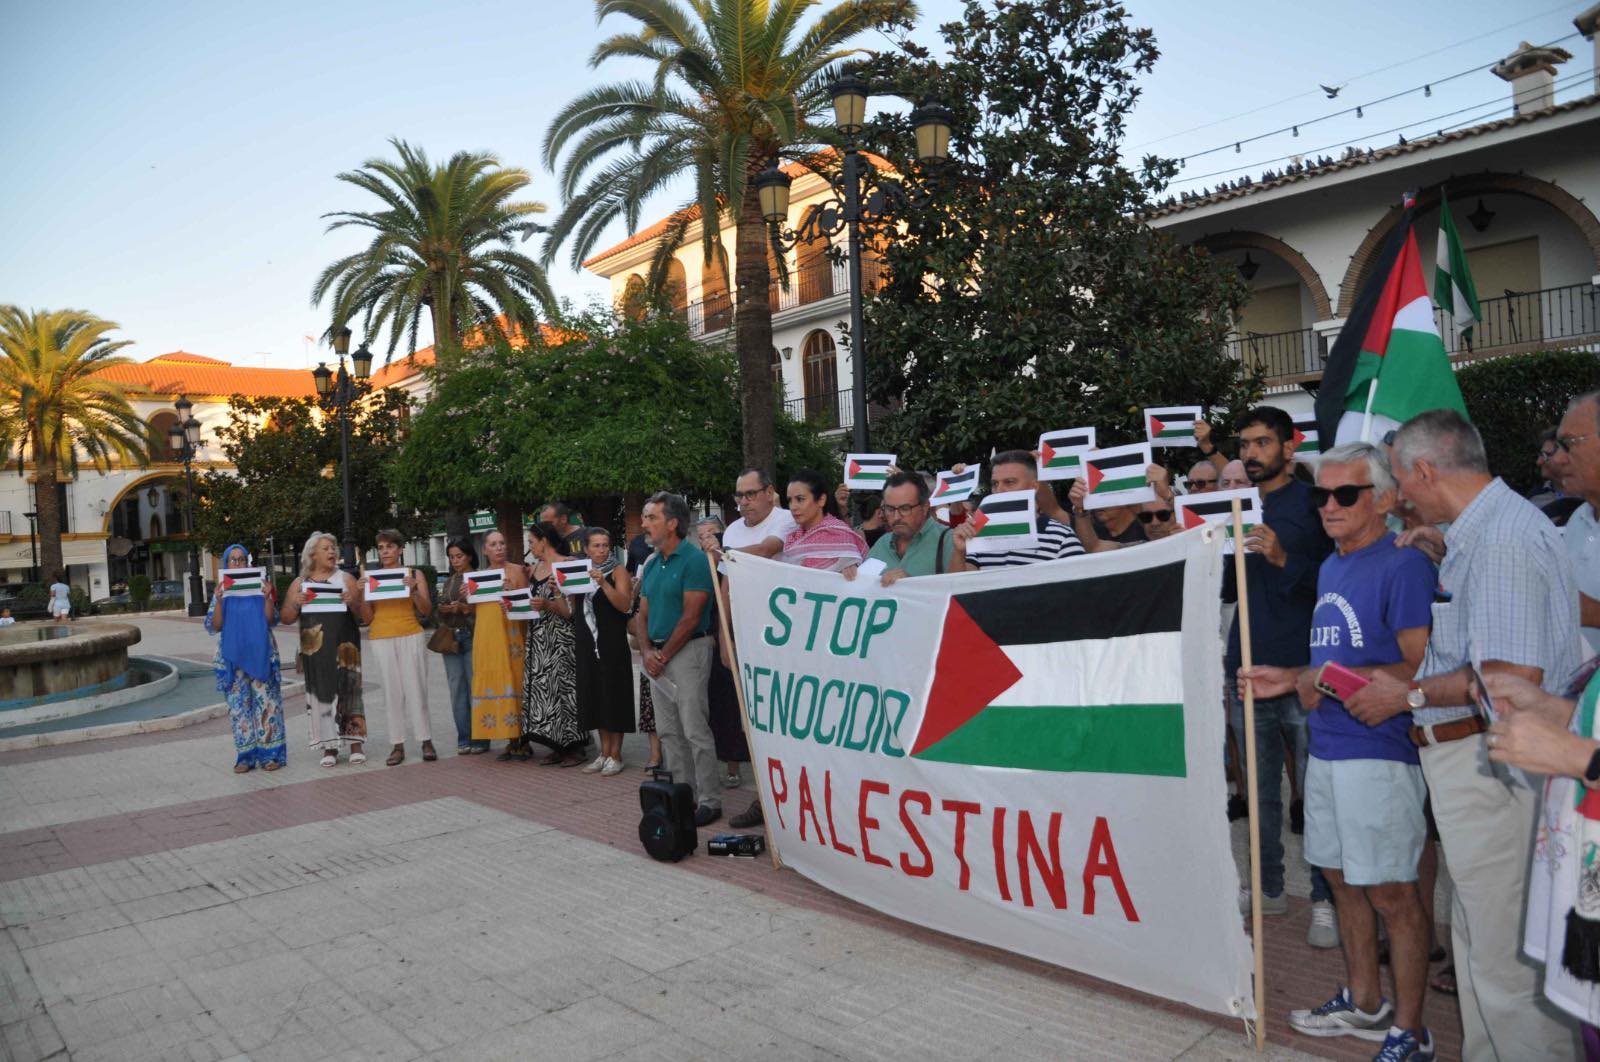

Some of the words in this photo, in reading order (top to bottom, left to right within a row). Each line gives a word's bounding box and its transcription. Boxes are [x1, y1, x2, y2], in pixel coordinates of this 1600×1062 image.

[764, 587, 898, 659] STOP
[1309, 625, 1341, 647] LIFE
[768, 757, 1140, 922] PALESTINA
